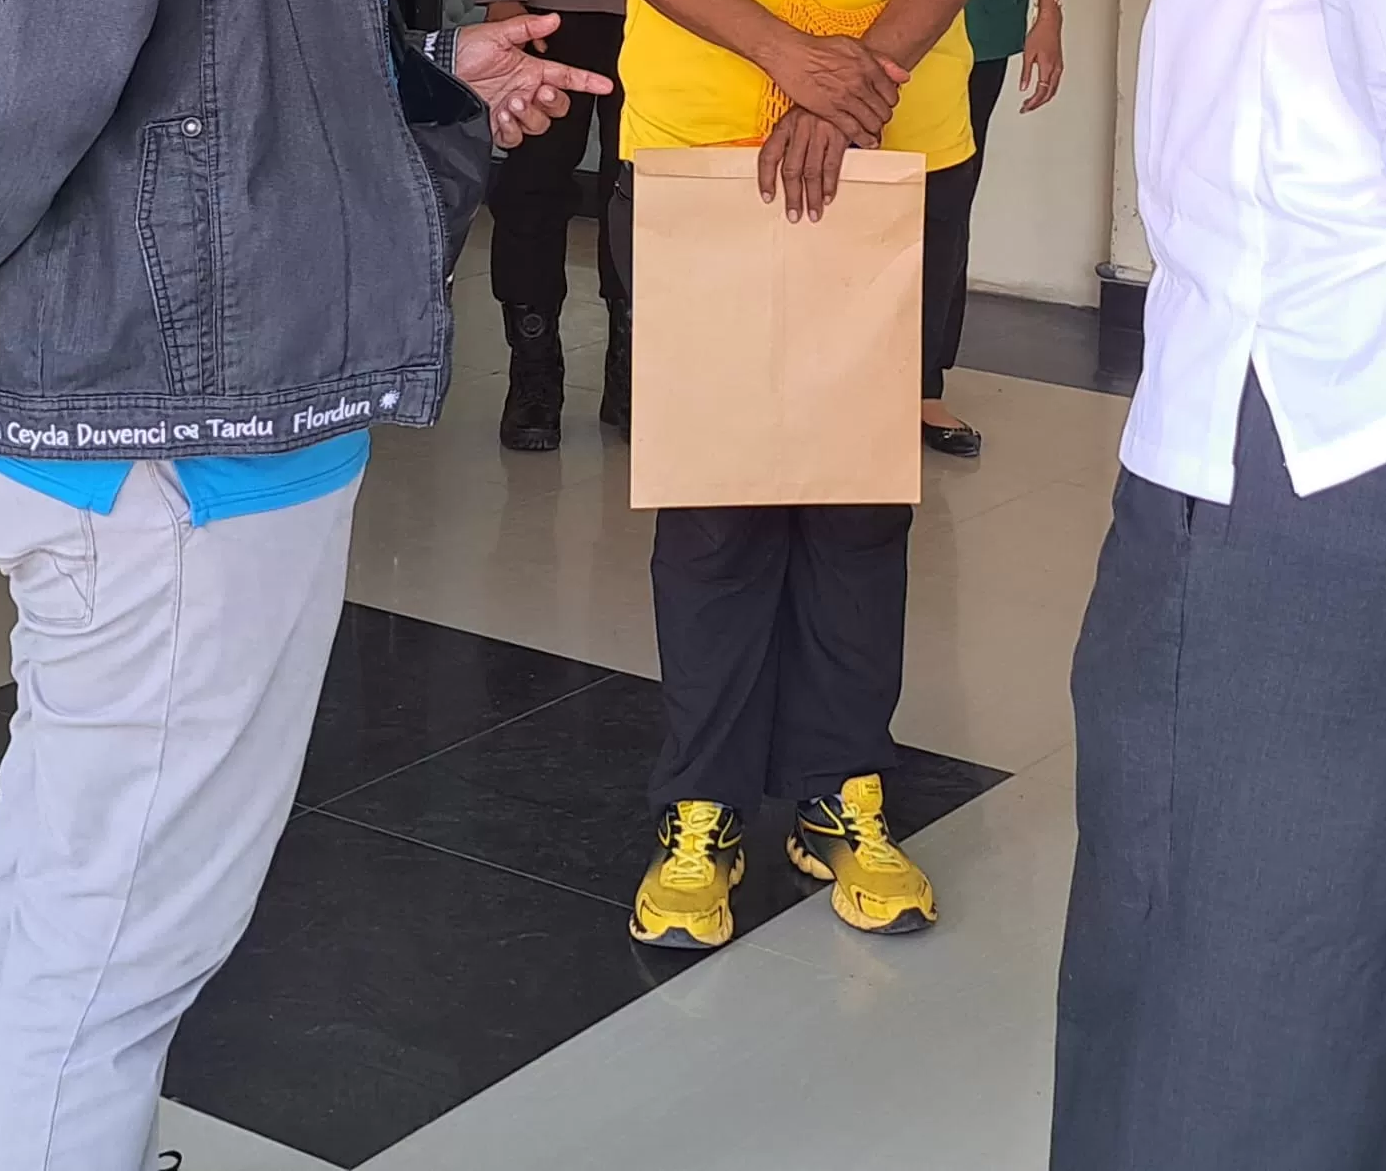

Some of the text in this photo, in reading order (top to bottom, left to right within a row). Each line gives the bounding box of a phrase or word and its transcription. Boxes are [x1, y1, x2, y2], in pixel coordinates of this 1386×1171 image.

[7, 422, 69, 451] Ceyda
[77, 421, 166, 446] Duvenci
[205, 415, 274, 439] Tardu
[293, 396, 372, 433] Flordun
